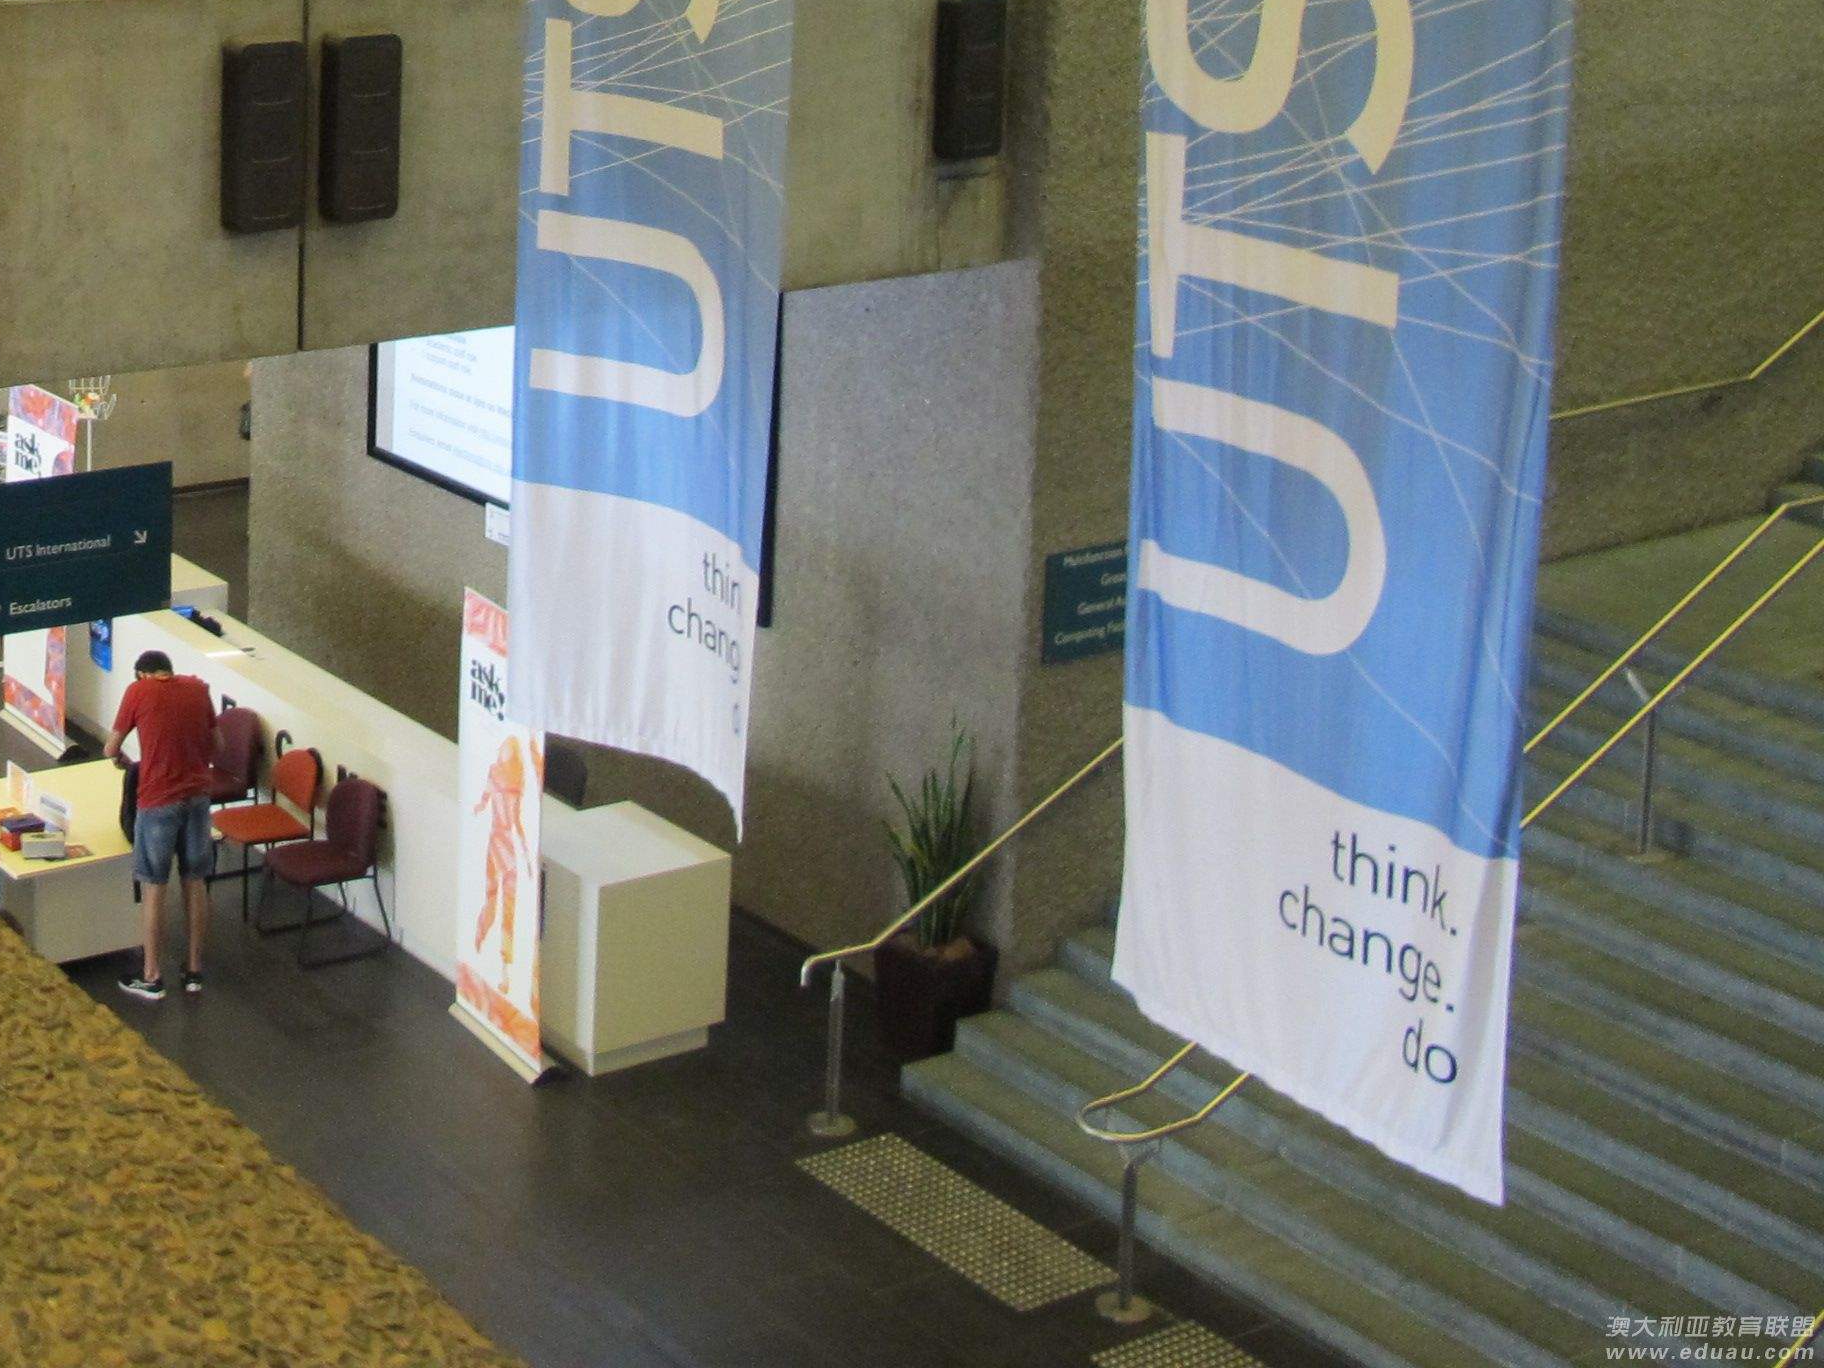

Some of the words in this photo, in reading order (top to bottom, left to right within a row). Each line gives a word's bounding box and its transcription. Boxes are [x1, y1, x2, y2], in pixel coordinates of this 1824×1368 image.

[5, 543, 33, 561] UTS
[35, 535, 111, 557] International
[9, 596, 72, 616] Escalators
[702, 552, 741, 616] thin
[667, 596, 741, 685] chang
[1330, 829, 1458, 937] think.
[1278, 884, 1455, 1013] change.
[1402, 1017, 1458, 1084] do
